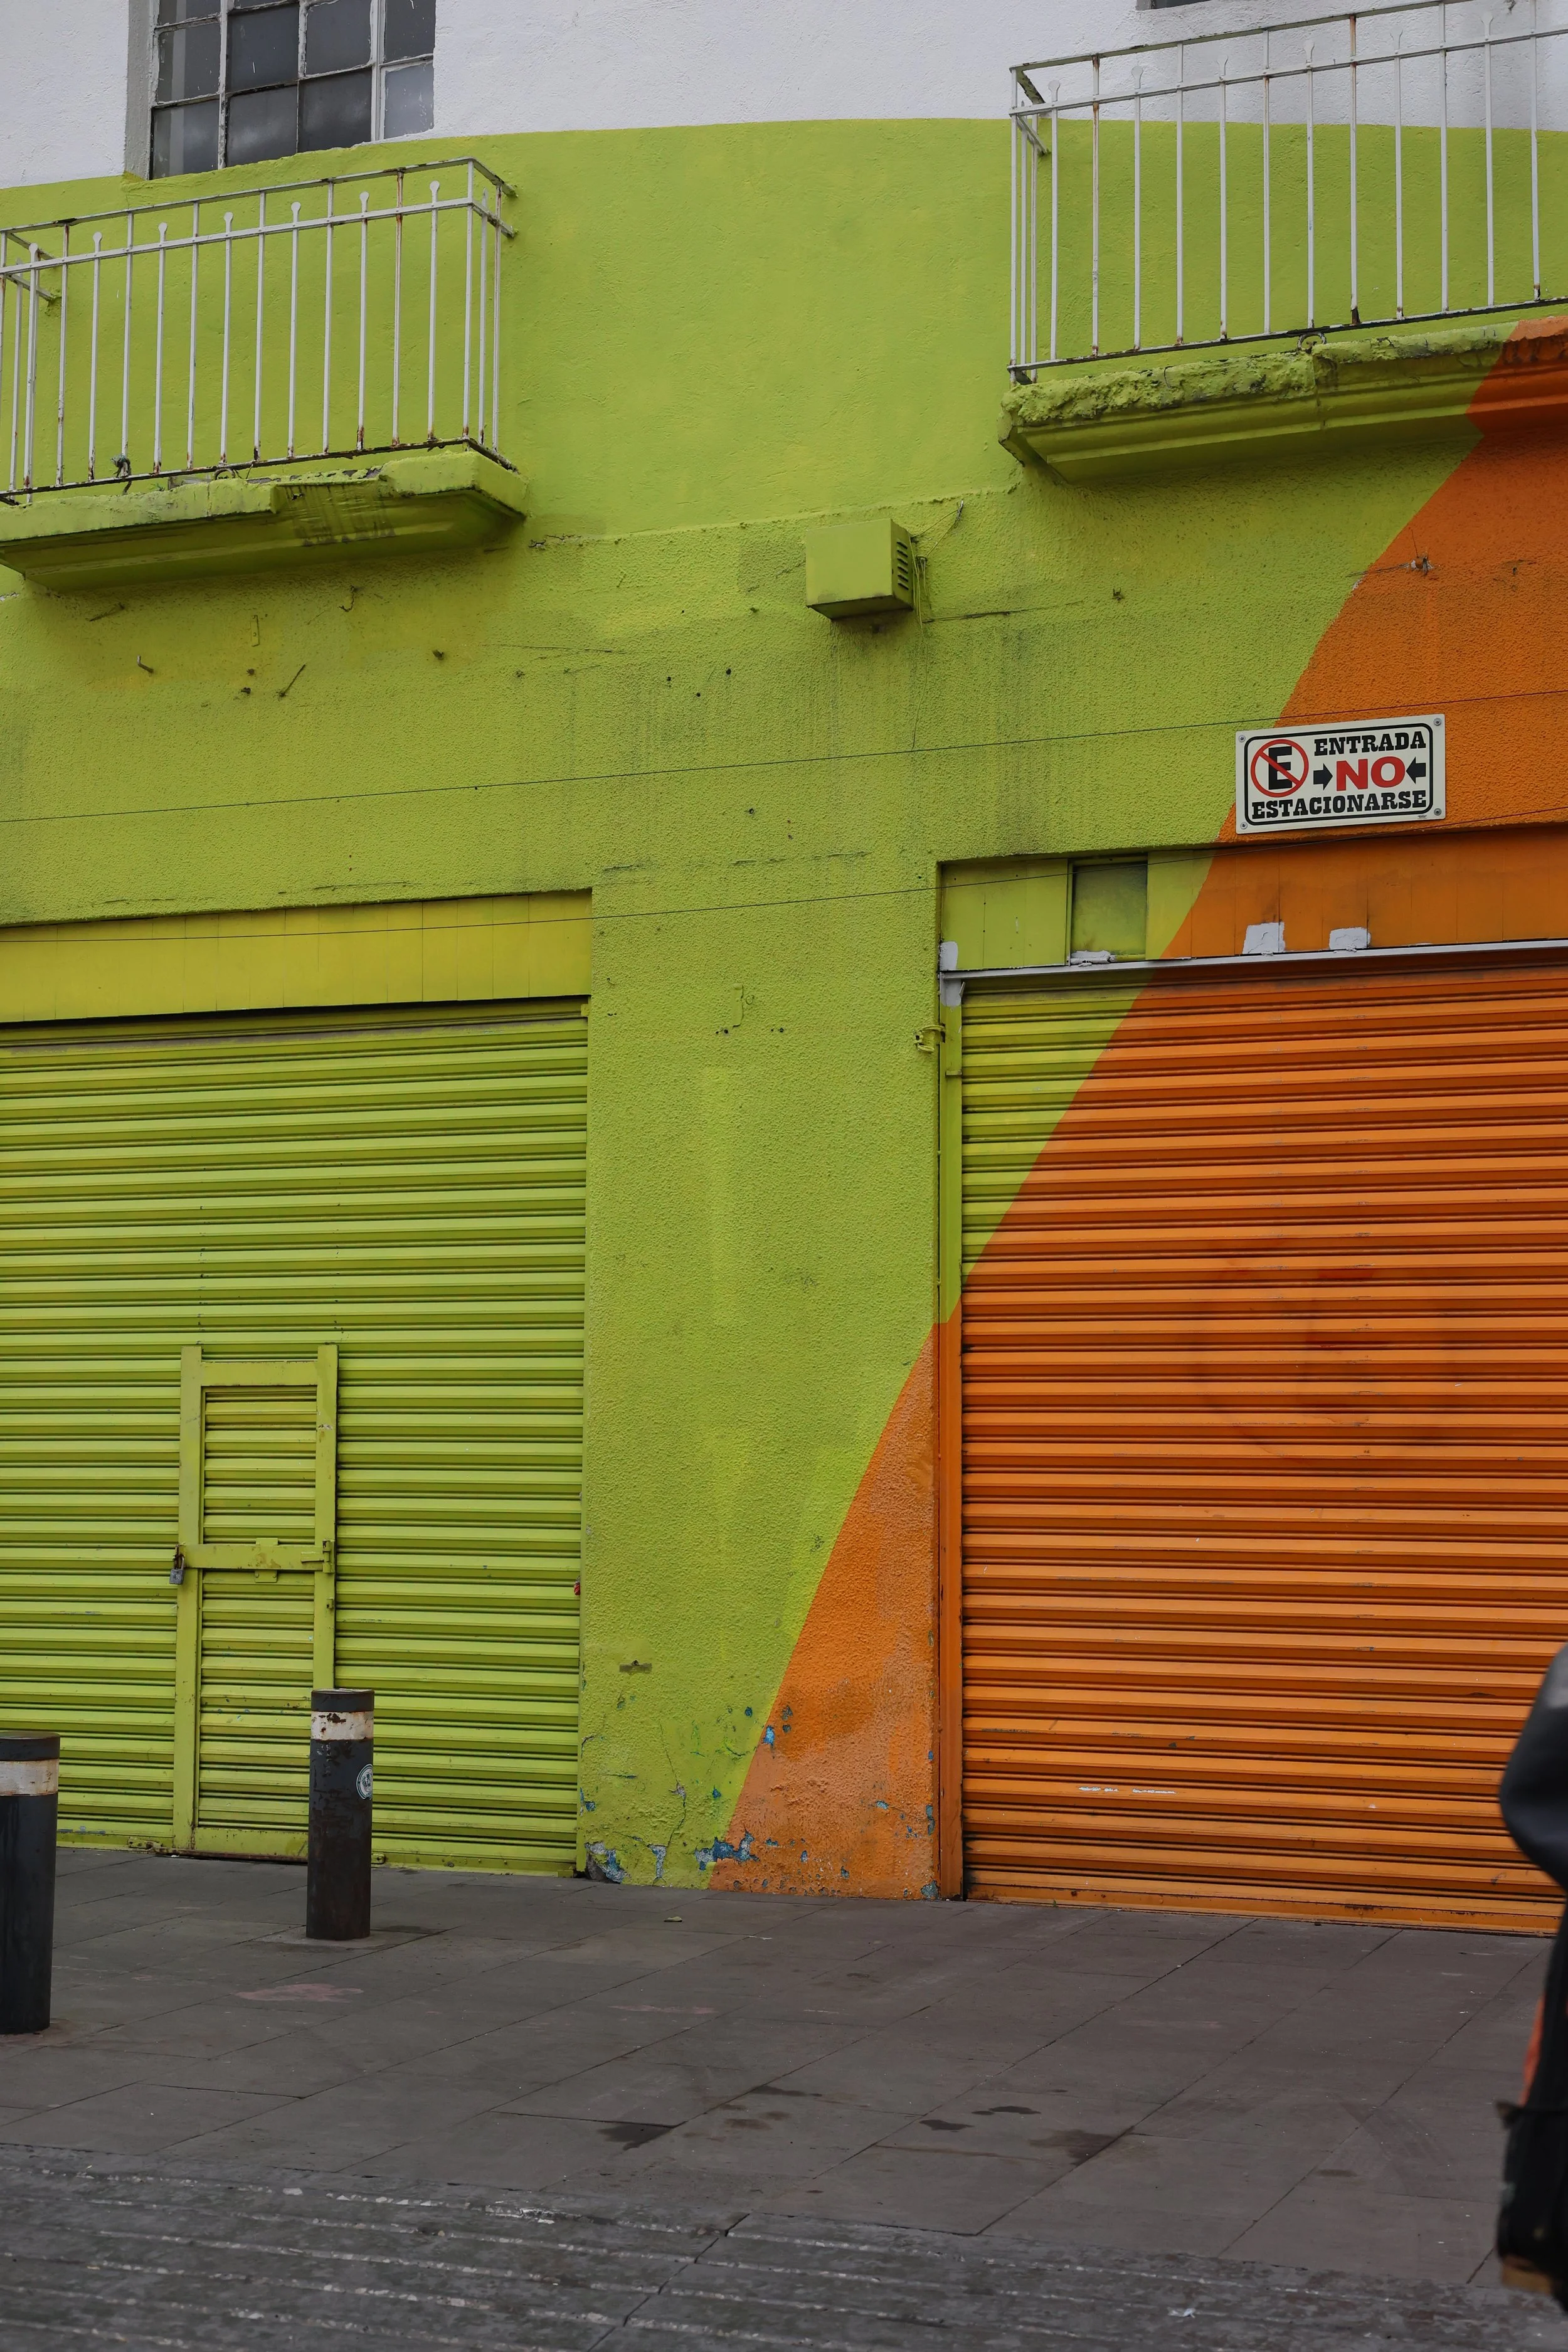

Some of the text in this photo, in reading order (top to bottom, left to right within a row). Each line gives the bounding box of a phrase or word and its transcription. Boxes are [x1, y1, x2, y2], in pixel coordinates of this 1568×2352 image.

[1314, 731, 1426, 756] ENTRADA
[1268, 745, 1293, 790] E
[1337, 756, 1406, 791] NO
[1251, 790, 1427, 820] ESTACIONARSE
